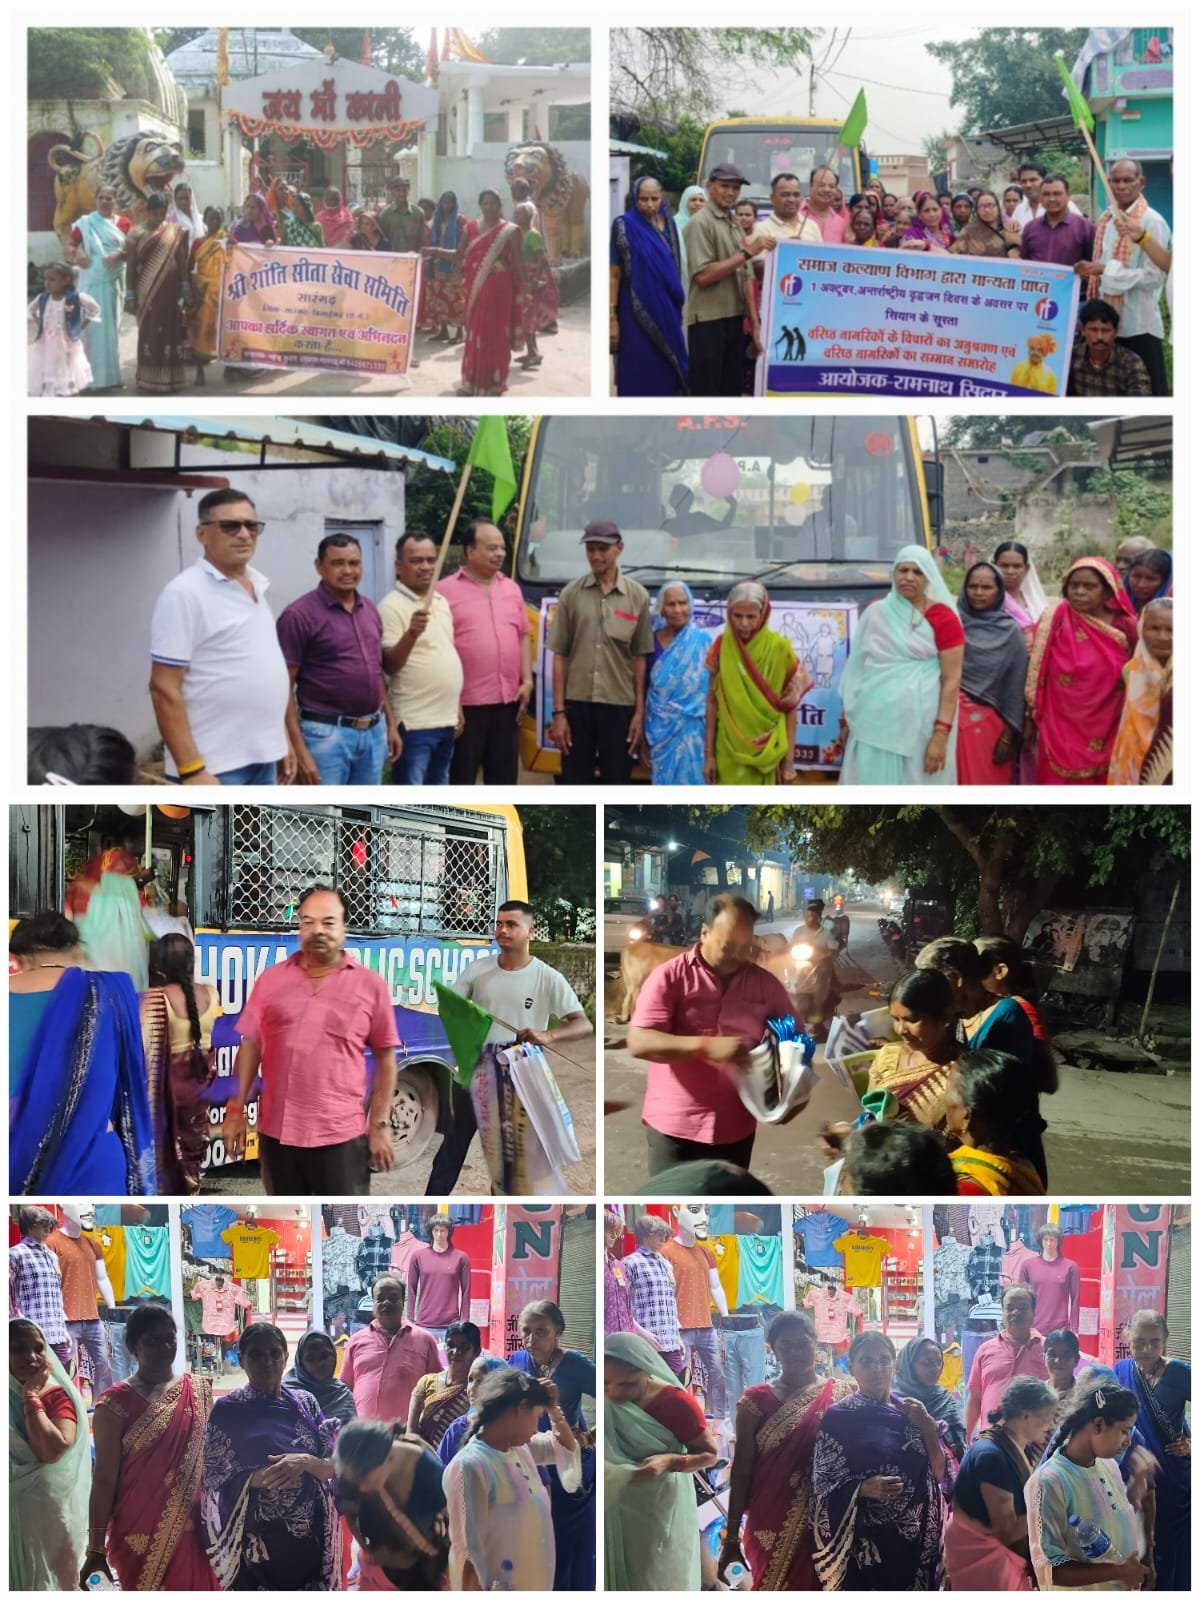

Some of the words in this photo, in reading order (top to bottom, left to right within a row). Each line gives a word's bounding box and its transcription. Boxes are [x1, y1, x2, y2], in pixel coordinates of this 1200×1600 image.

[262, 89, 302, 121] जय
[346, 79, 401, 121] काली
[228, 273, 247, 300] श्री
[250, 262, 288, 290] शांति
[293, 257, 328, 283] सीता
[332, 259, 361, 290] सेवा
[364, 275, 410, 317] समिति
[798, 258, 838, 273] समाज
[842, 261, 891, 278] कल्याण
[896, 263, 936, 281] विभाग
[941, 270, 967, 285] द्वारा
[971, 273, 1016, 290] मान्यता
[1020, 279, 1049, 294] प्राप्त
[885, 307, 916, 322] सियान
[919, 311, 930, 322] के
[943, 290, 969, 305] दिवस
[971, 294, 982, 306] के
[984, 298, 1013, 310] अवसर
[1016, 302, 1029, 312] पर
[227, 320, 263, 334] आपका
[808, 325, 836, 340] वरिष्ठ
[840, 326, 885, 342] नागरिकों
[887, 328, 898, 342] के
[901, 329, 934, 346] विचारों
[936, 336, 951, 348] का
[1001, 343, 1017, 359] एवं
[823, 343, 852, 359] वरिष्ठ
[855, 345, 900, 361] नागरिकों
[902, 349, 918, 361] का
[920, 351, 954, 366] सम्मान
[957, 355, 998, 374] समारोह
